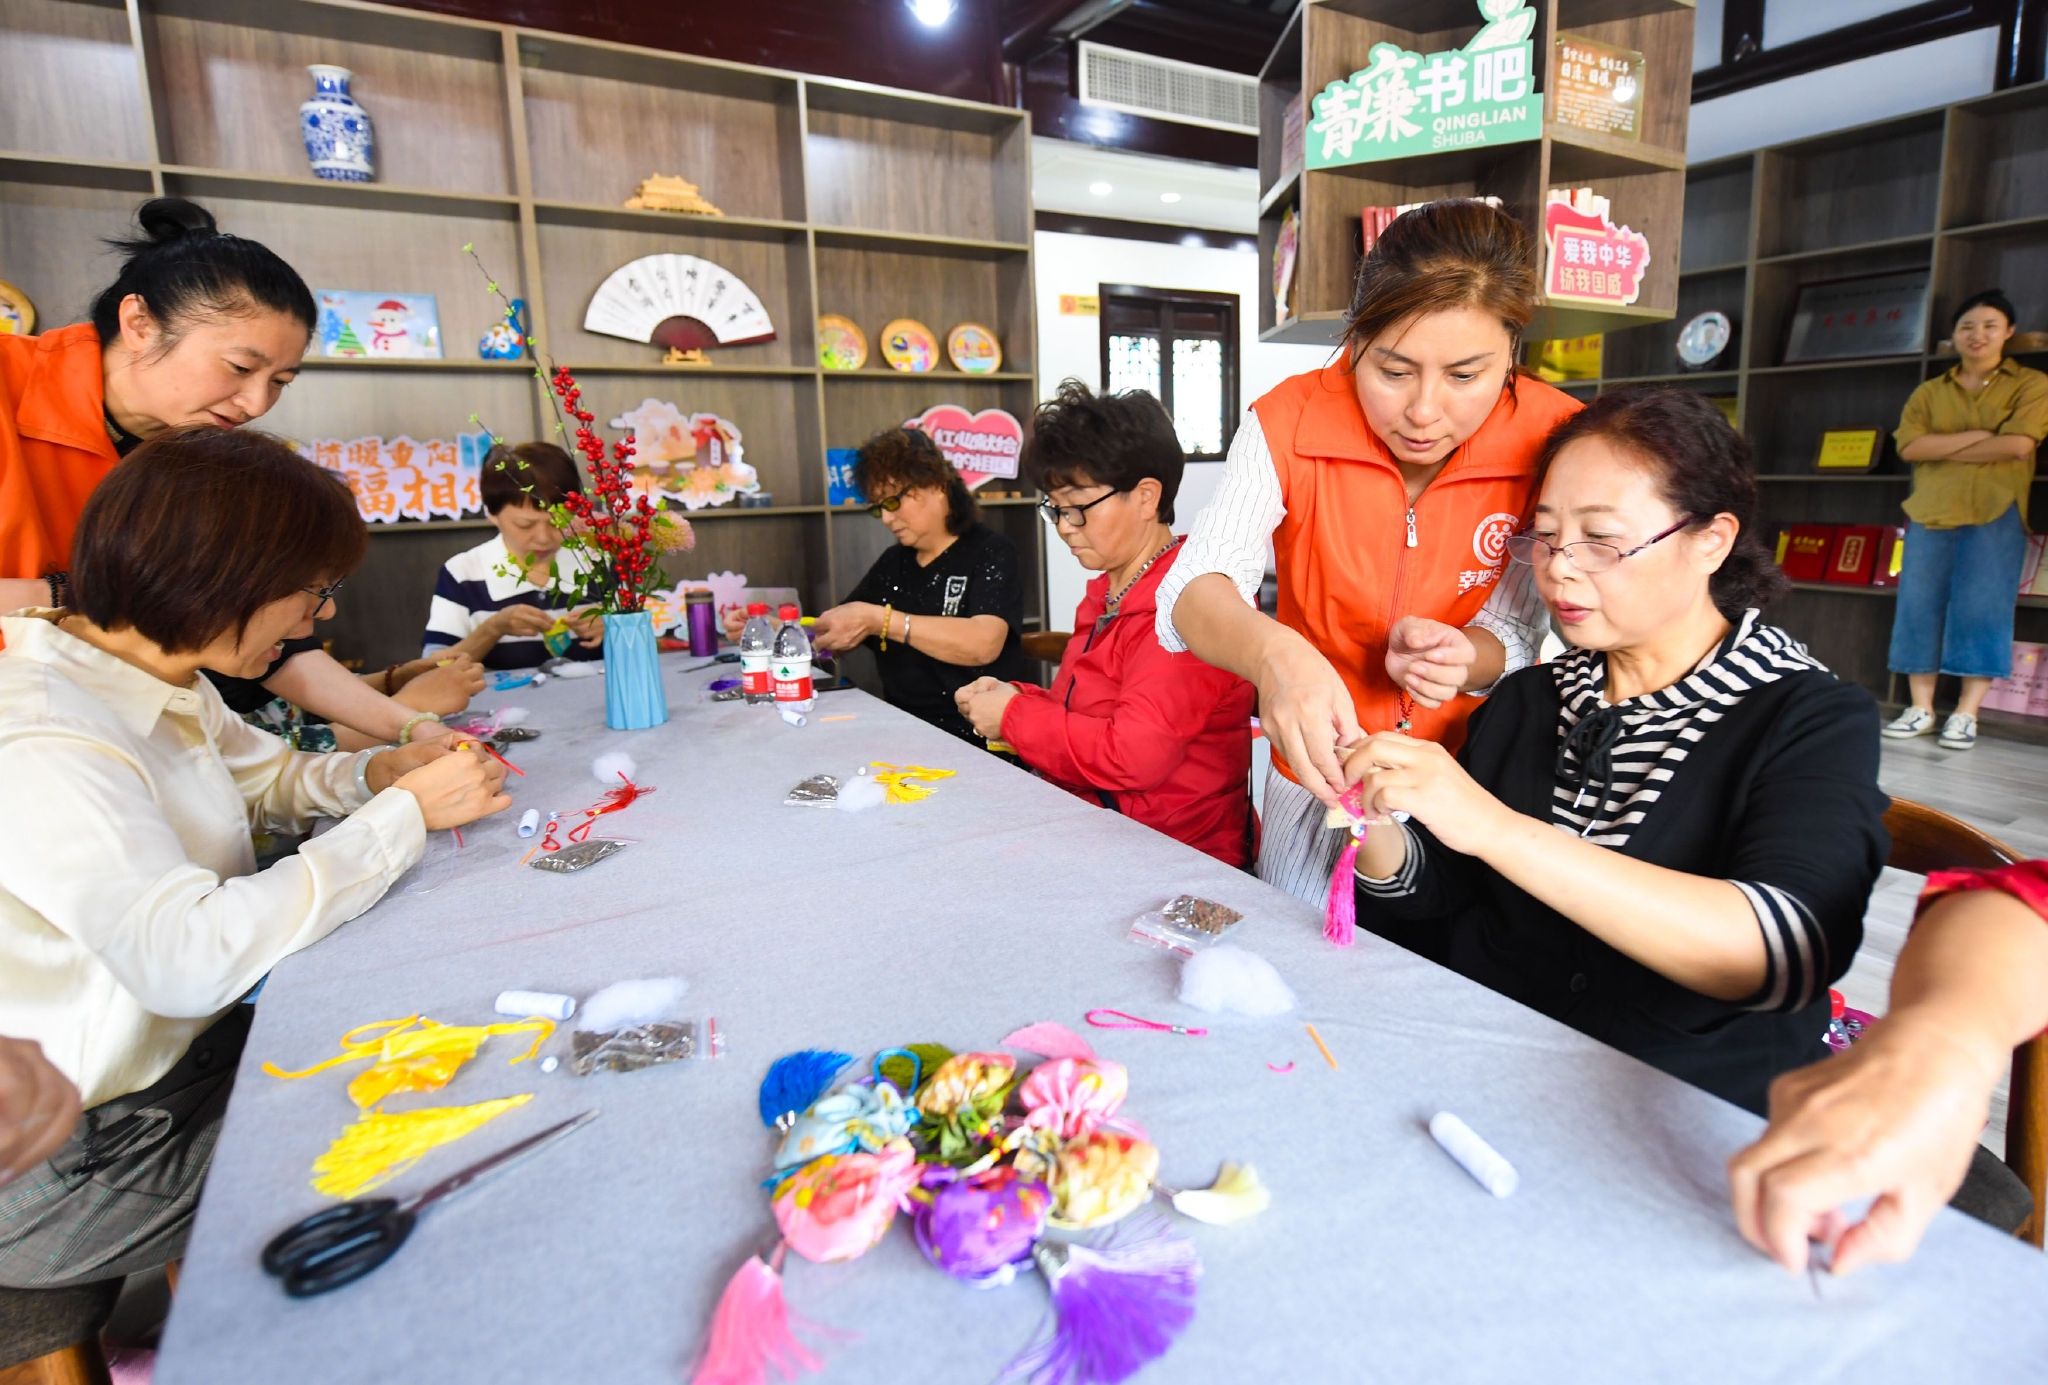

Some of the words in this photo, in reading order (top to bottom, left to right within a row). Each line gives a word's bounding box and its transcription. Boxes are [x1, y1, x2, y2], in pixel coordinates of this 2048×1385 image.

[1313, 47, 1527, 160] 青廉书吧
[1432, 105, 1527, 134] QINGLIAN
[1432, 130, 1486, 149] SHUBA
[1563, 237, 1632, 269] 爱我中华
[1560, 266, 1622, 296] 扬我国威
[315, 439, 457, 470] 情暖重阳
